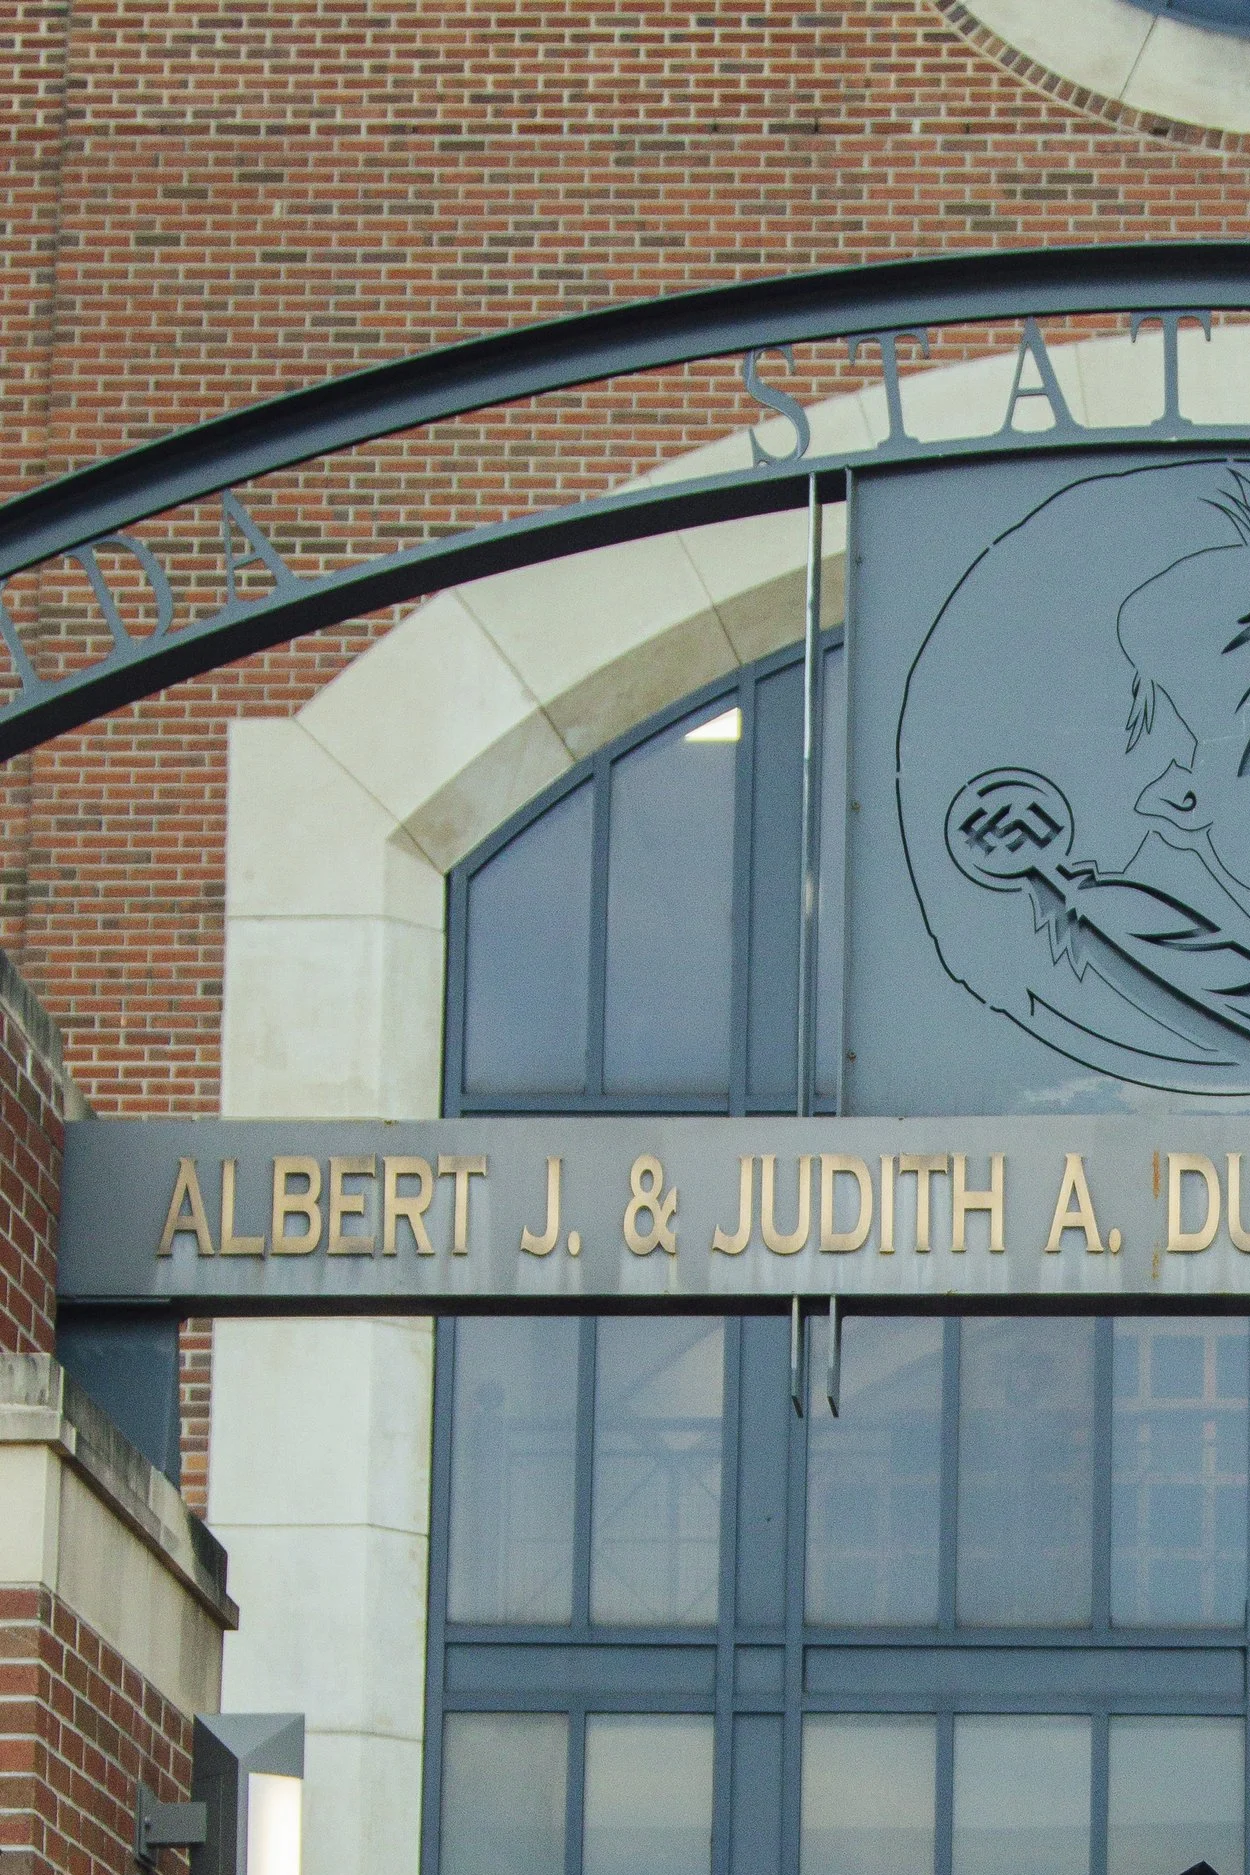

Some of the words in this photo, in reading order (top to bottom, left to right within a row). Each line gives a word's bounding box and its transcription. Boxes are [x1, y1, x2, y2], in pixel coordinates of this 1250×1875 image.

[156, 1154, 488, 1257] ALBERT
[520, 1155, 582, 1257] J.
[623, 1153, 678, 1256] &
[712, 1152, 1005, 1257] JUDITH
[1044, 1152, 1123, 1255] A.
